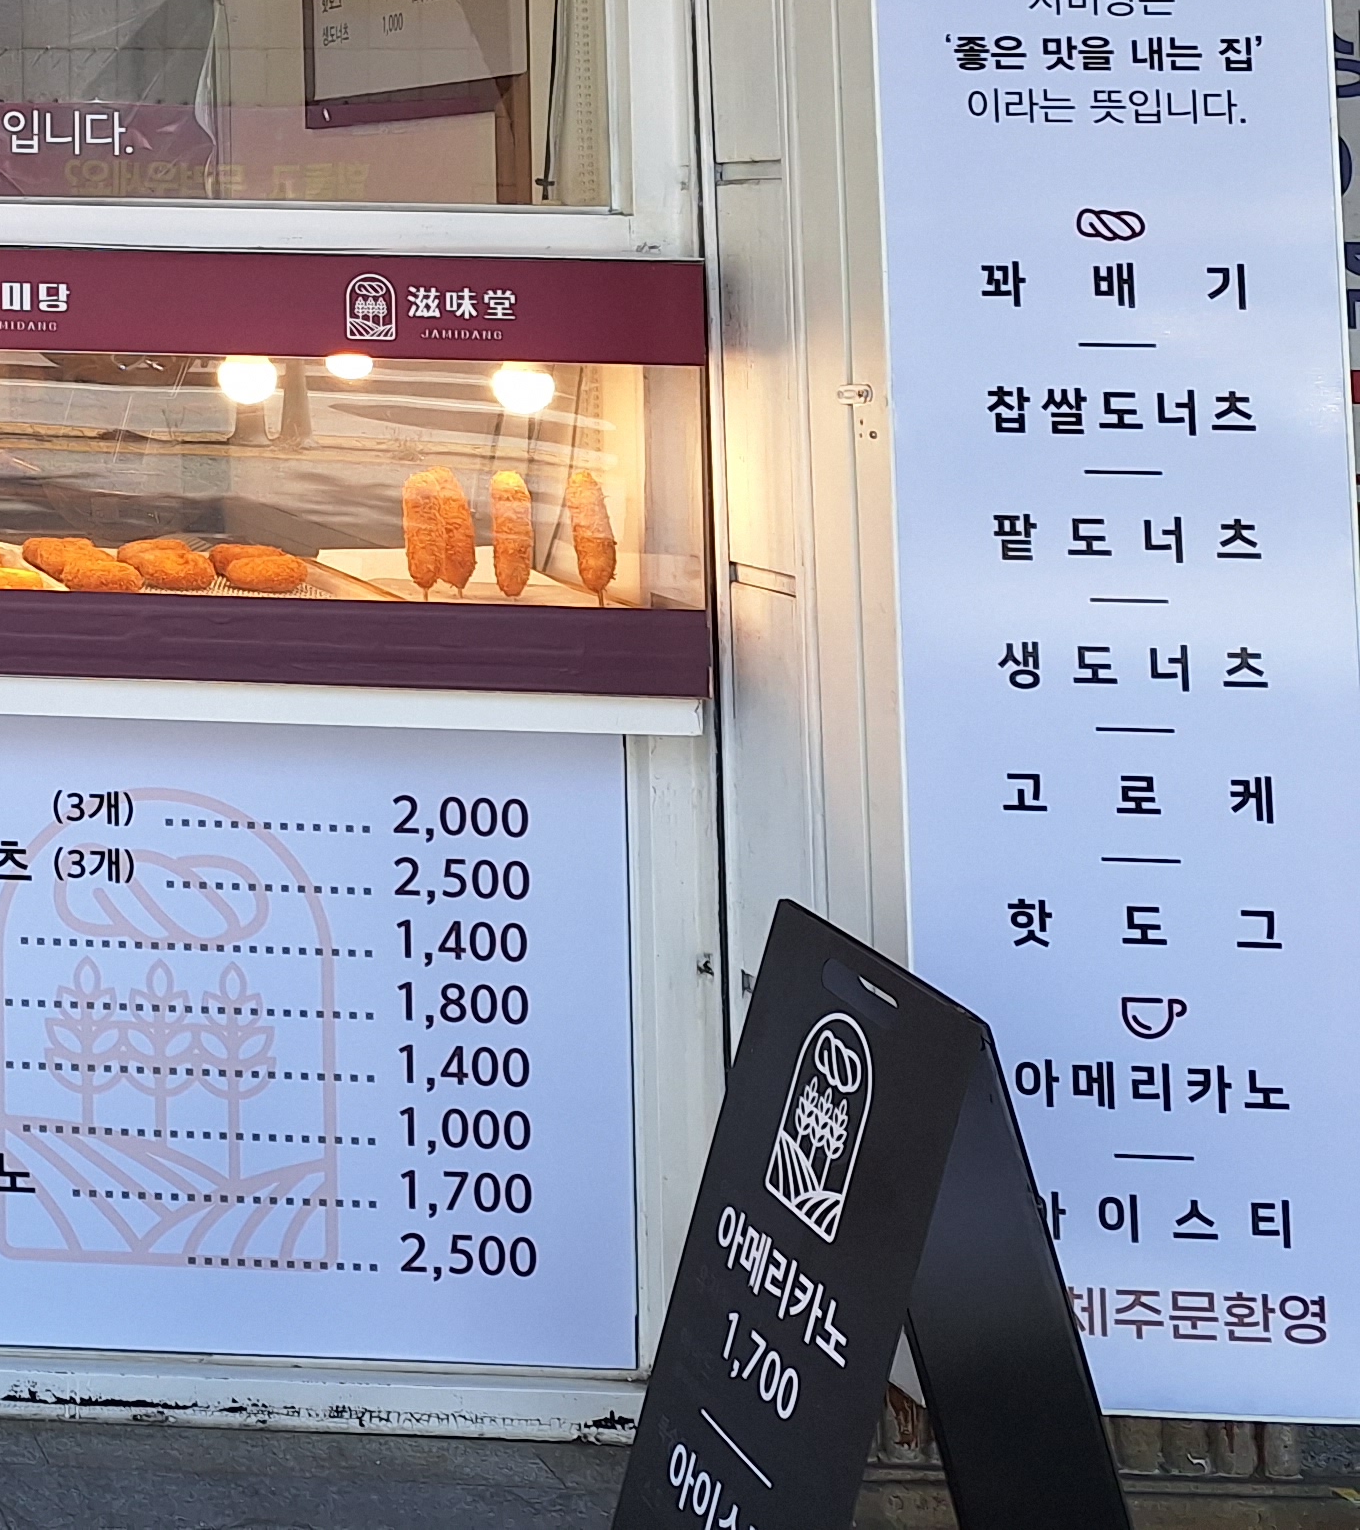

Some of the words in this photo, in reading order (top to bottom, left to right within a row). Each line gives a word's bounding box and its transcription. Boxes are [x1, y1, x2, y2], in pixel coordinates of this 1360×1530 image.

[322, 23, 350, 47] 생도너츠
[382, 13, 403, 36] 1,000
[1042, 36, 1115, 71] 맛을
[1131, 37, 1204, 72] 내는
[967, 88, 1076, 123] 이라는
[1090, 89, 1247, 125] 뜻입니다.
[3, 109, 135, 157] 입니다.
[406, 285, 517, 322] 滋味堂
[980, 261, 1247, 310] 꽈배기
[419, 328, 503, 341] JAMIDANG
[986, 386, 1256, 436] 찹쌀도너츠
[992, 514, 1262, 563] 팥도너츠
[998, 641, 1269, 692] 생도너츠
[52, 790, 135, 827] (3개)
[392, 794, 530, 843] 2,000
[1002, 773, 1276, 824] 고로케
[53, 847, 136, 883] (3개)
[393, 856, 531, 905] 2,500
[396, 919, 528, 967] 1,400
[1008, 898, 1283, 950] 핫도그
[397, 981, 529, 1030] 1,800
[398, 1044, 531, 1093] 1,400
[1015, 1061, 1291, 1115] 아메리카노
[399, 1106, 532, 1155] 1,000
[400, 1169, 533, 1219] 1,700
[400, 1232, 538, 1282] 2,500
[717, 1206, 848, 1368] 아메리카노
[722, 1312, 799, 1420] 1,700
[669, 1444, 757, 1530] 아이
